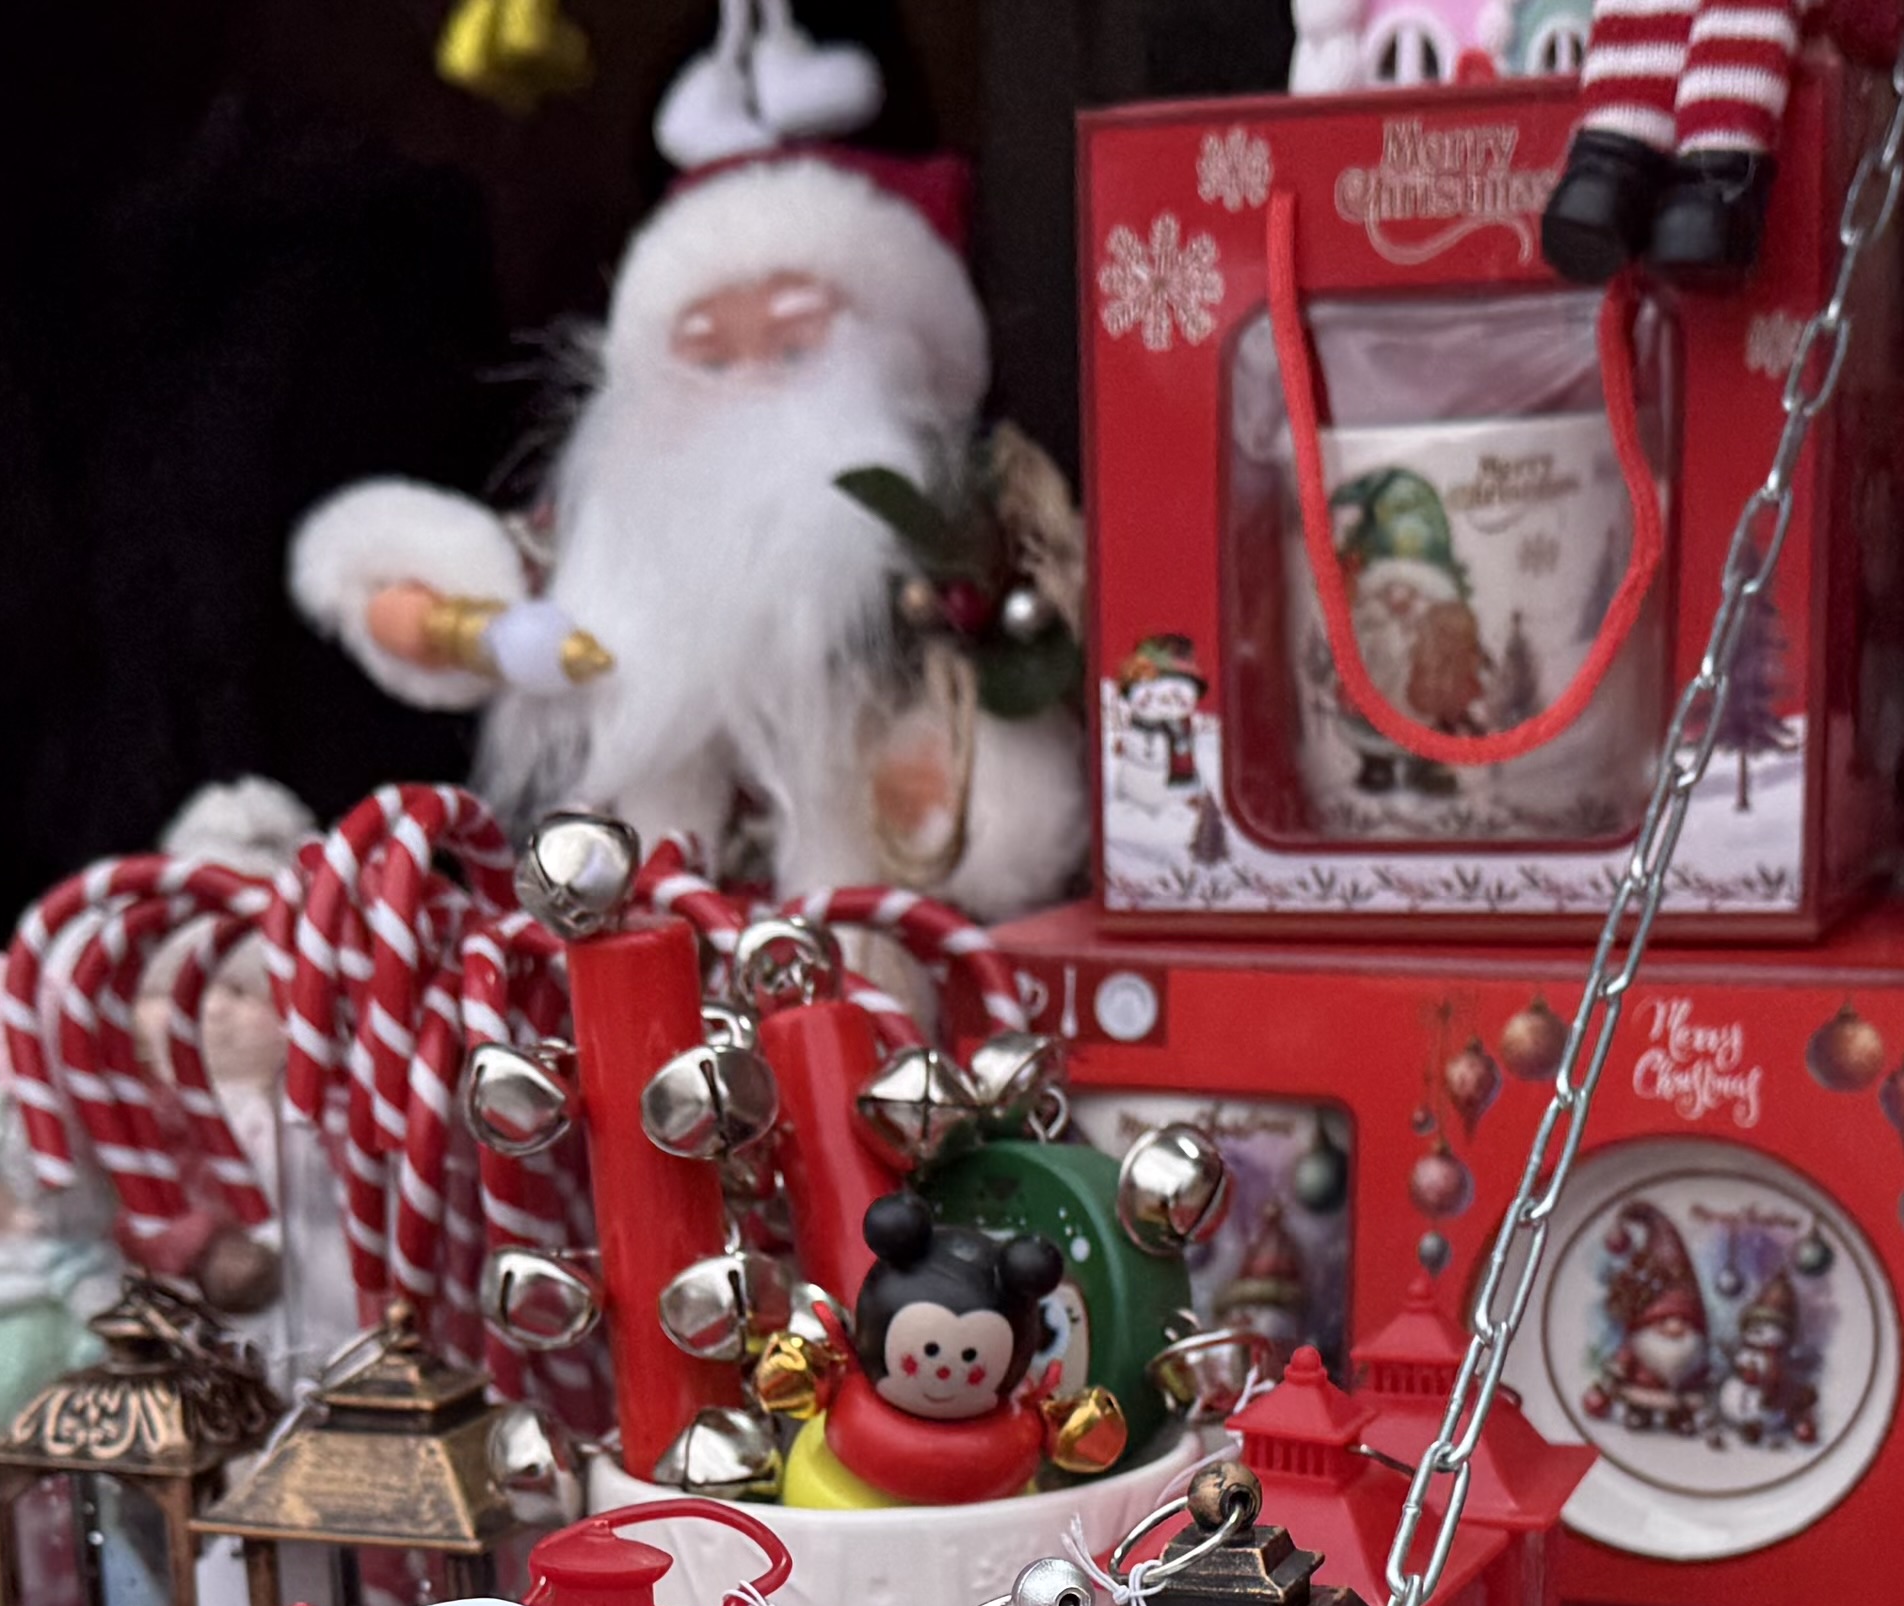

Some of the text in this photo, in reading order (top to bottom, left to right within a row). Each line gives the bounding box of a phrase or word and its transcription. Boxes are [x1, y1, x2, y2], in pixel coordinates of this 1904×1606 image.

[1380, 117, 1519, 176] Merry
[1629, 997, 1744, 1072] Merry
[1633, 1047, 1763, 1129] Christmas
